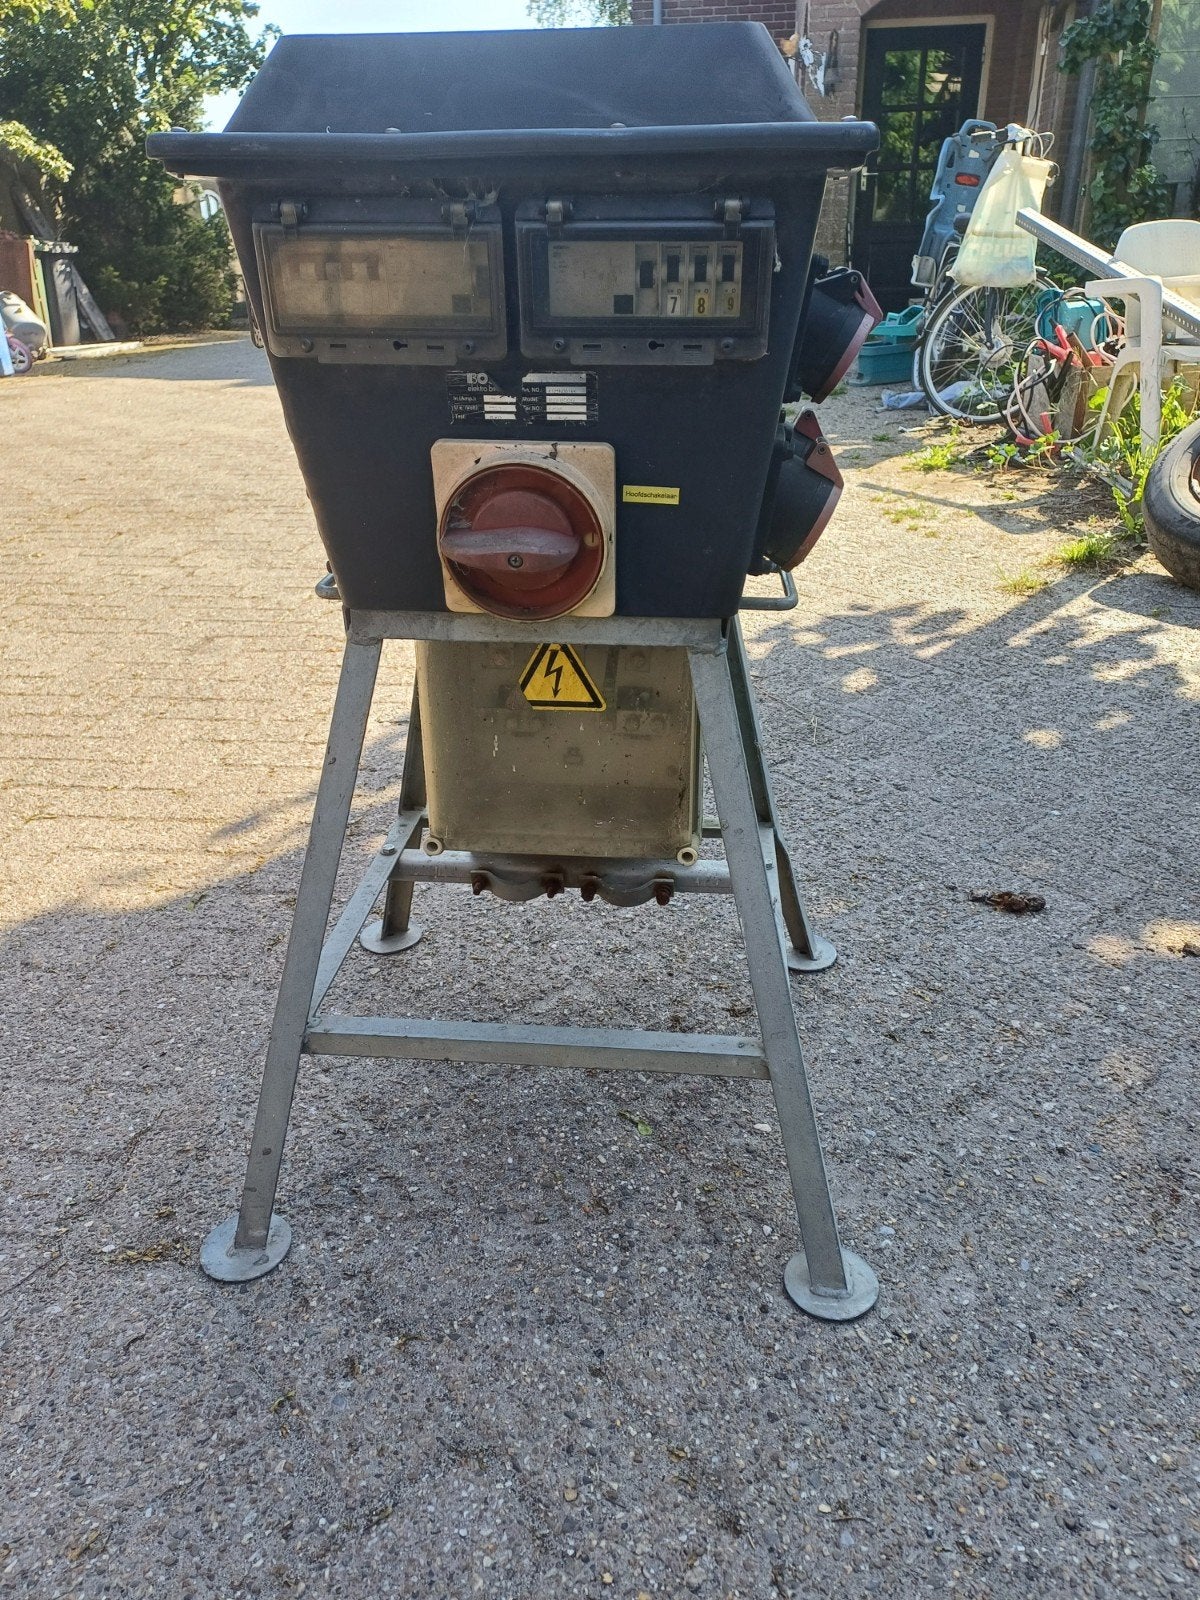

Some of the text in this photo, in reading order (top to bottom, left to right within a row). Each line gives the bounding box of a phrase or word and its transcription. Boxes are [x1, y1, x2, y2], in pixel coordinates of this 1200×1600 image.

[670, 296, 678, 314] 7
[697, 297, 706, 314] 8
[727, 297, 735, 311] 9
[625, 490, 677, 499] Hoofdschakelaar
